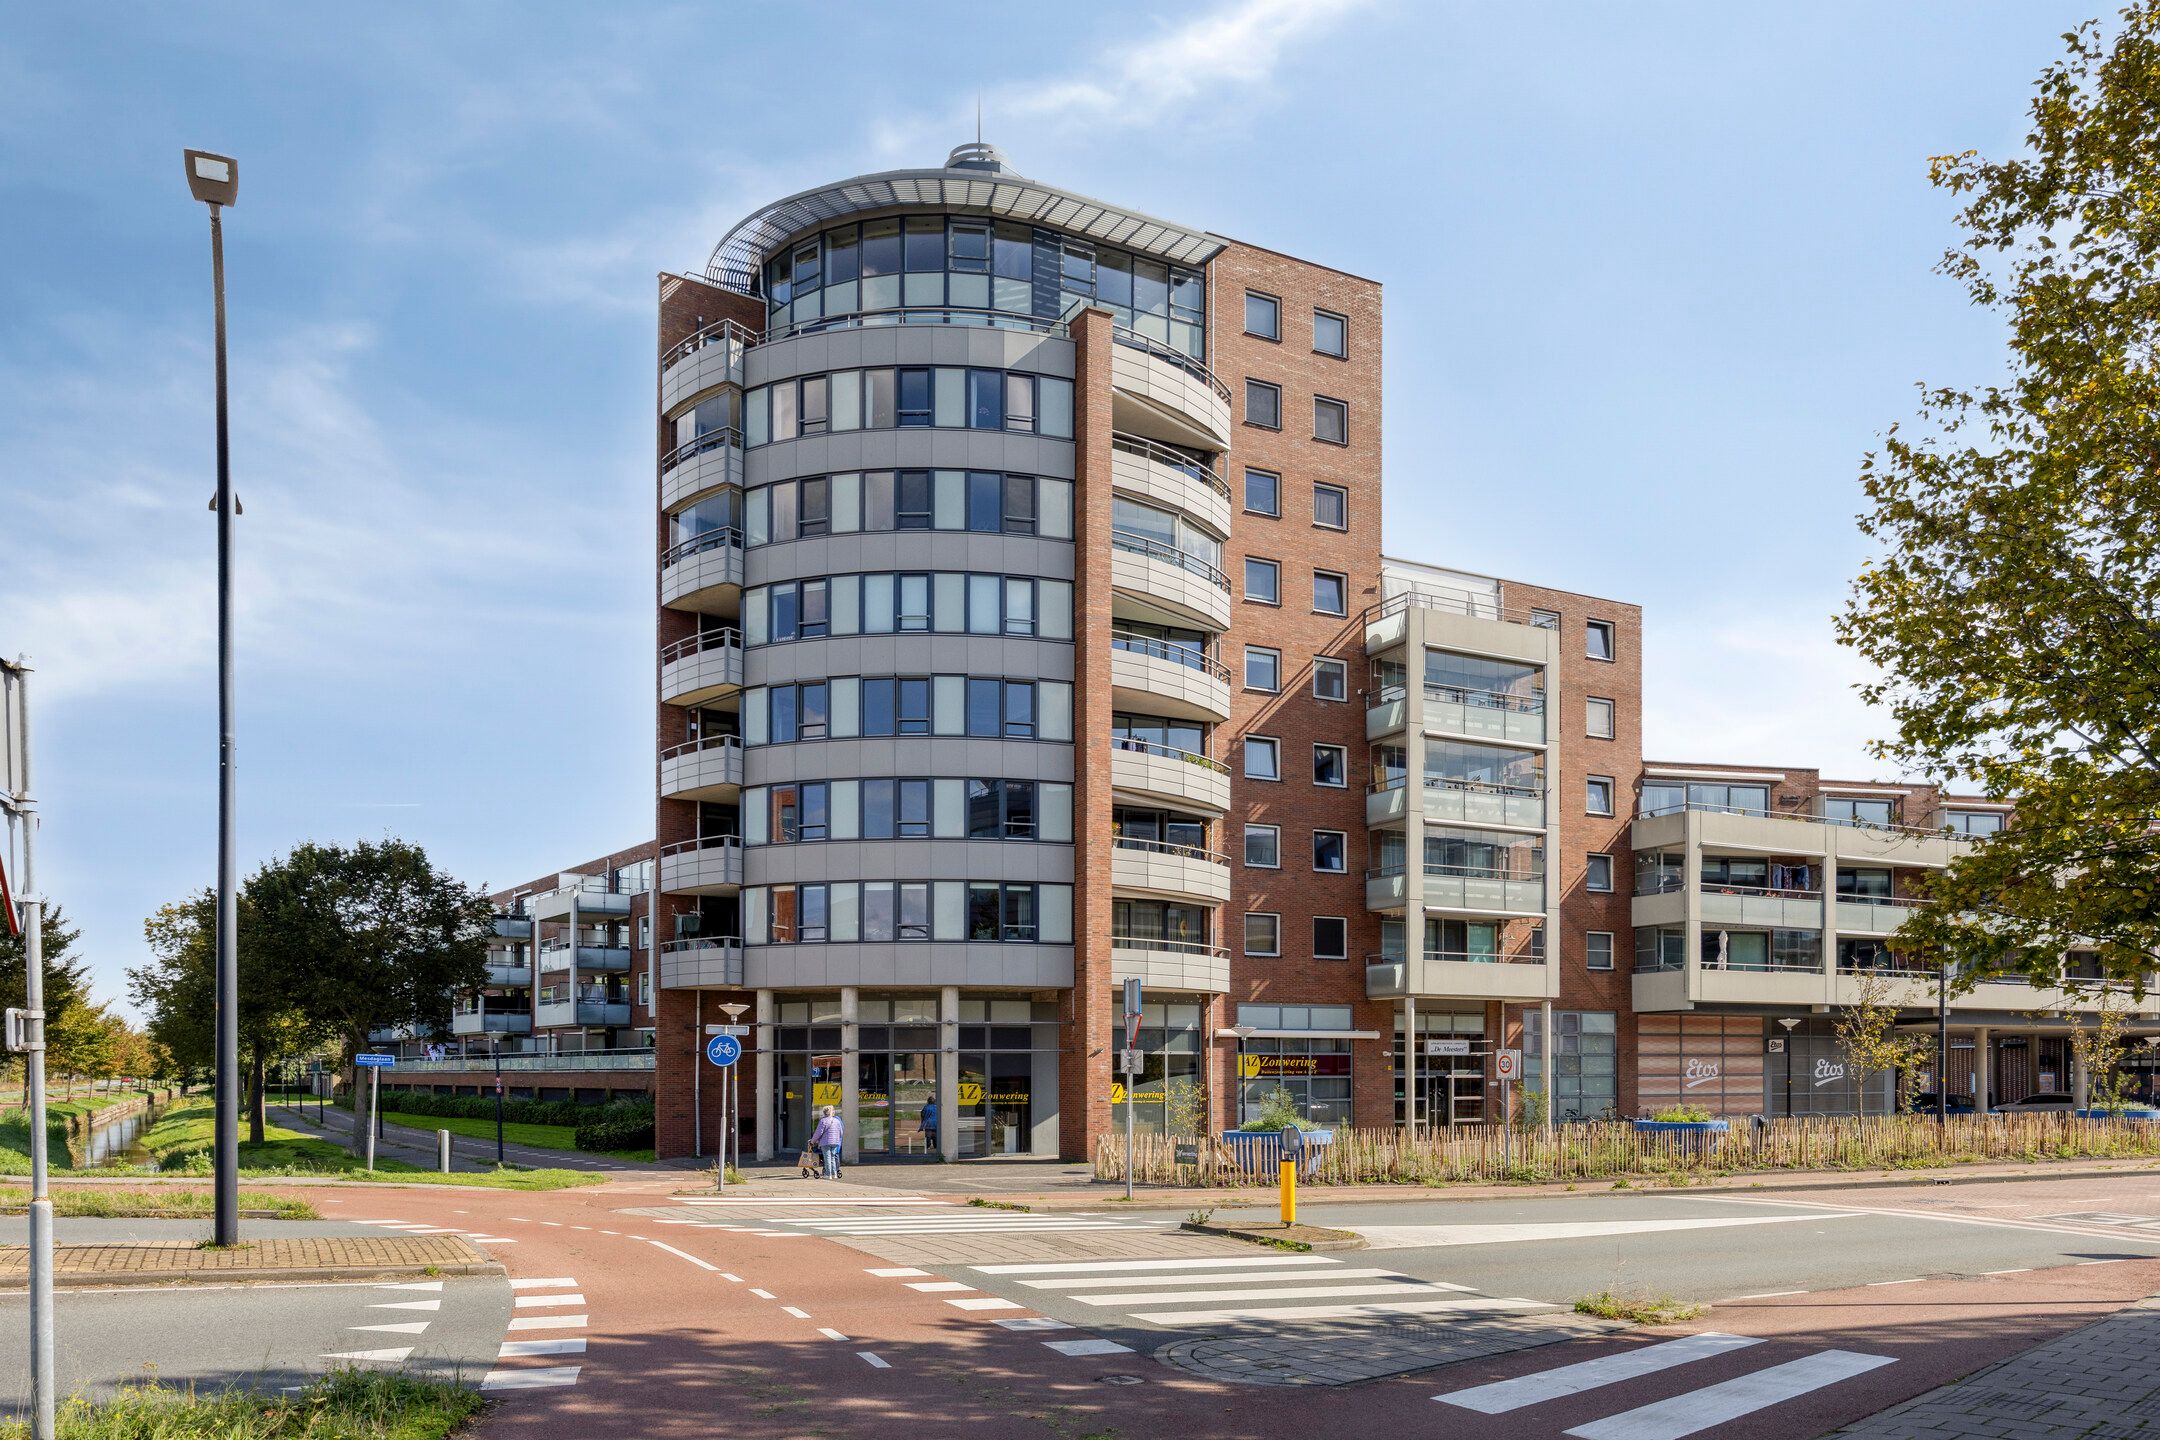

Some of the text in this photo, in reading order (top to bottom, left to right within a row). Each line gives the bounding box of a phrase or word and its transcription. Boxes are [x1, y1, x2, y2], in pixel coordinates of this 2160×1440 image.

[1261, 1056, 1317, 1069] Zonwering
[1501, 1060, 1510, 1069] 30
[1686, 1058, 1719, 1079] Etos
[1814, 1058, 1844, 1079] Etos
[819, 1084, 840, 1099] AZ
[957, 1084, 1029, 1101] AZ Zonwering
[1122, 1090, 1165, 1100] Znwering
